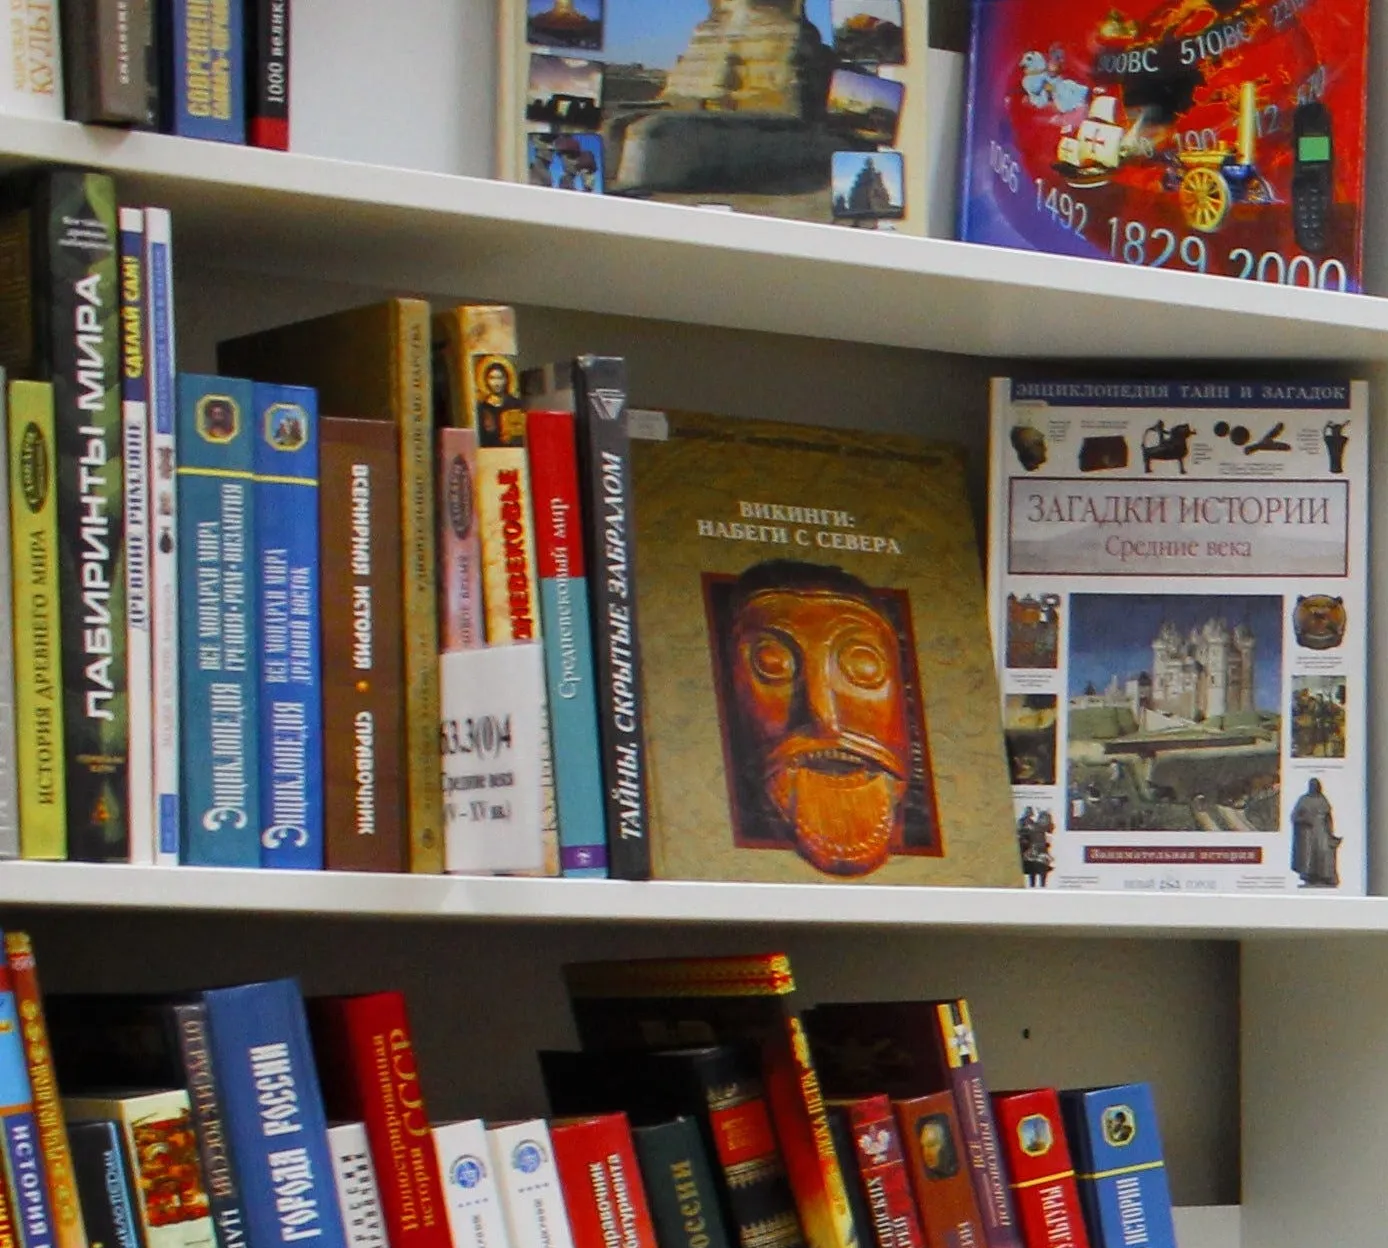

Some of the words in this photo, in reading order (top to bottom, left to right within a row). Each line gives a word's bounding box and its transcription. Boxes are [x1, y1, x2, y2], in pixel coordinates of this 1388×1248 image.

[1180, 20, 1255, 66] 510BC
[1034, 178, 1088, 239] 1492
[1108, 217, 1207, 275] 1829
[1229, 248, 1346, 292] 2000
[73, 273, 104, 410] МИРА
[33, 528, 47, 585] МИРА
[350, 463, 373, 575] ВСЕМИРНАЯ
[599, 451, 630, 599] ЗАБРАЛОМ
[698, 518, 790, 546] НАБЕГИ
[794, 527, 809, 548] С
[816, 529, 901, 556] СЕВЕРА
[741, 499, 856, 530] ВИКИНГИ:
[1027, 494, 1172, 526] ЗАГАДКИ
[1180, 494, 1328, 526] ИСТОРИИ
[1104, 535, 1198, 560] Средние
[1205, 535, 1252, 560] века
[77, 425, 114, 722] ЛАБИРИНТЫ
[34, 591, 51, 700] ДРЕВНЕГО
[352, 585, 374, 669] ИСТОРИЯ
[607, 604, 636, 734] СКРЫТЫЕ
[37, 706, 54, 807] ИСТОРИЯ
[354, 712, 376, 836] СПРАВОЧНИК
[613, 741, 642, 841] ТАЙНЫ,
[247, 1042, 303, 1137] РОССИИ
[11, 1124, 48, 1237] ИСТОРИЯ
[266, 1146, 321, 1242] ГОРОДА
